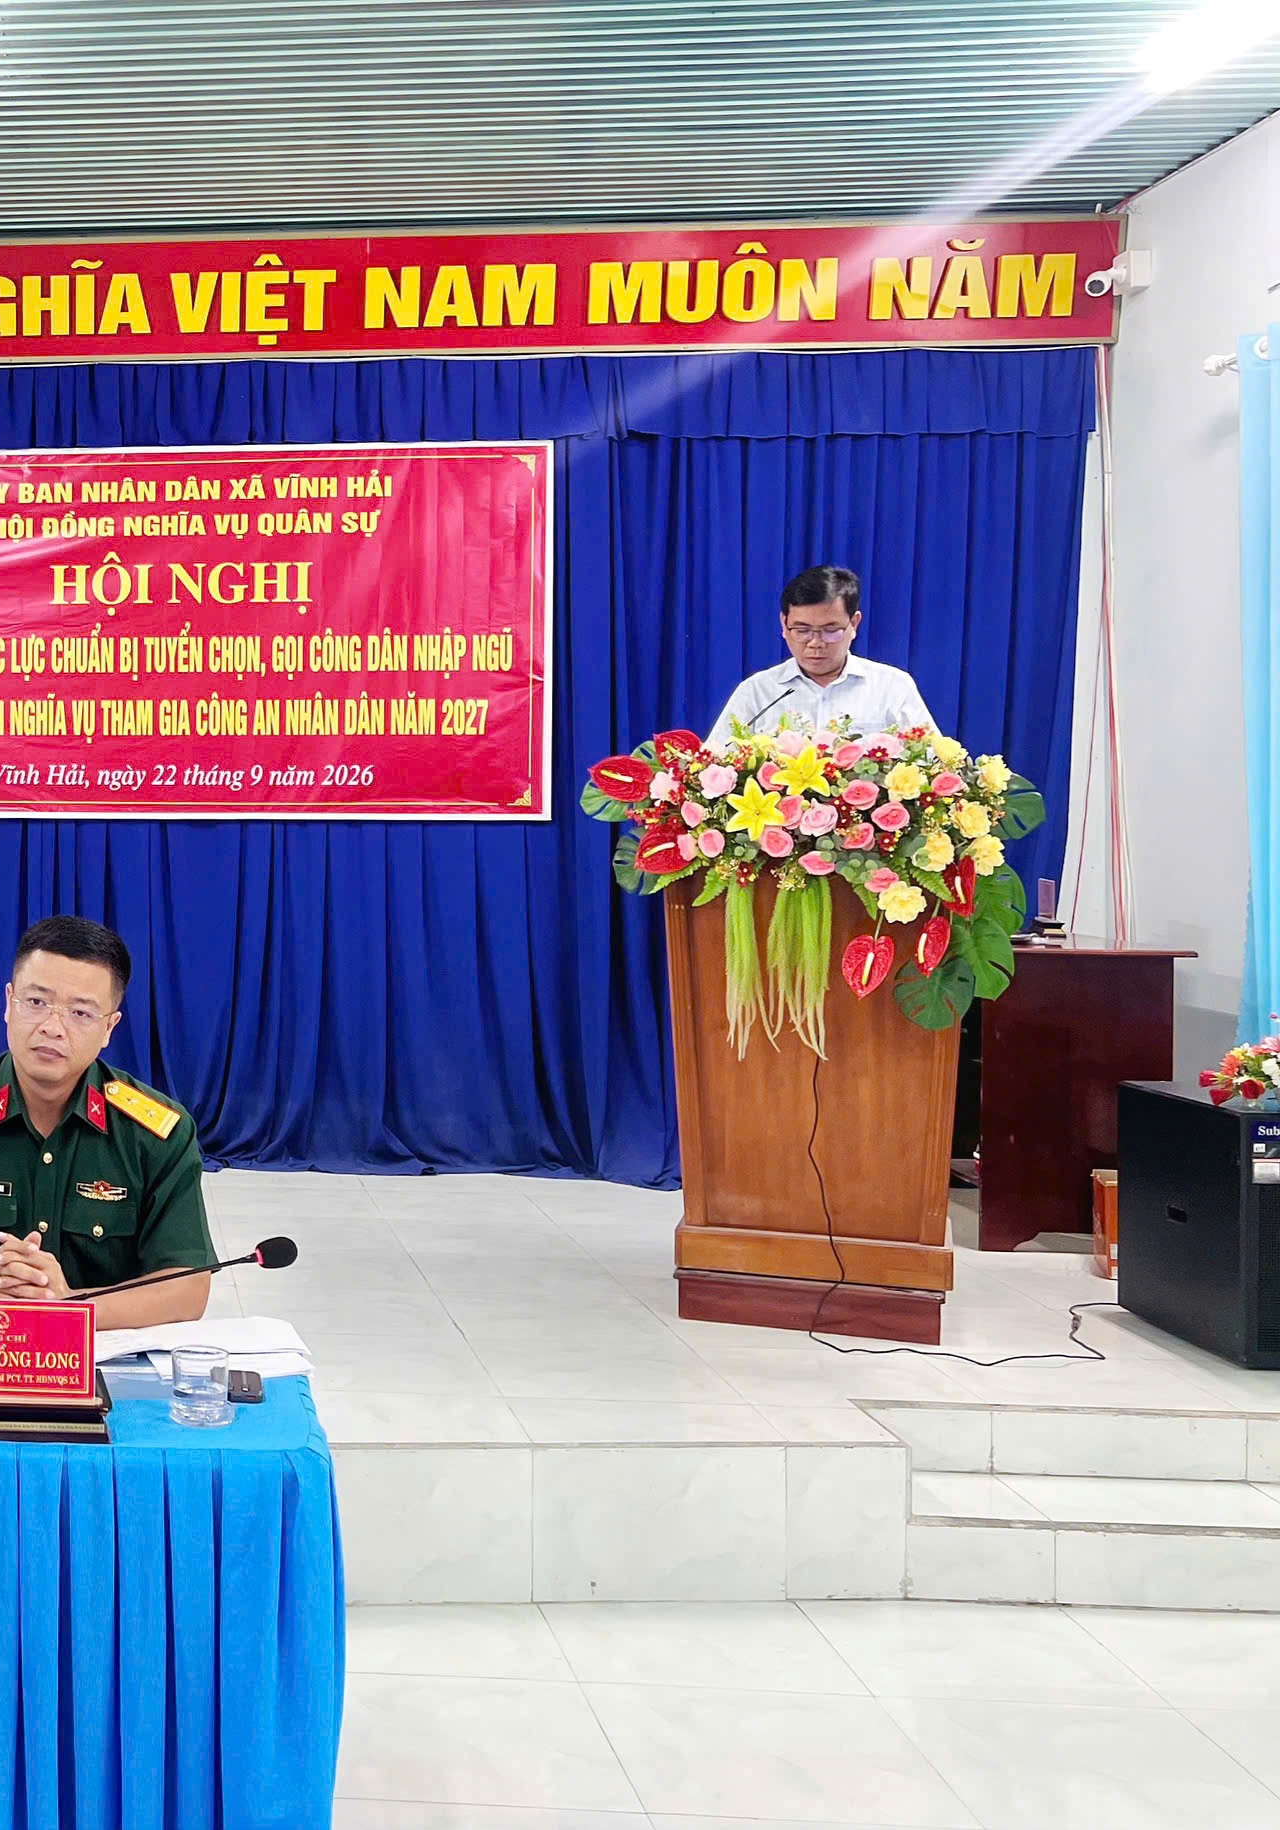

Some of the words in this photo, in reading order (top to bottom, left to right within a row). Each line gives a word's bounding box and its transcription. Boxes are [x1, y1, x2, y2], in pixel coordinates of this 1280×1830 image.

[170, 253, 337, 346] VIỆT
[365, 264, 557, 329] NAM
[587, 241, 841, 325] MUÔN
[869, 239, 1077, 321] NĂM
[17, 482, 73, 504] BAN
[81, 477, 157, 503] NHÂN
[165, 475, 221, 502] DÂN
[228, 474, 266, 500] XÃ
[273, 473, 338, 499] VĨNH
[346, 469, 393, 498] HẢI
[41, 511, 115, 538] ĐỒNG
[123, 511, 207, 537] NGHĨA
[214, 514, 249, 540] VỤ
[257, 508, 333, 537] QUÂN
[341, 509, 382, 538] SỰ
[49, 551, 154, 616] HỘI
[168, 561, 314, 615] NGHỊ
[11, 634, 46, 681] LỰC
[51, 622, 115, 674] CHUẨN
[119, 637, 139, 681] BỊ
[144, 621, 203, 673] TUYỂN
[208, 636, 266, 681] CHỌN,
[272, 636, 304, 681] GỌI
[309, 627, 362, 672] CÔNG
[367, 627, 408, 672] DÂN
[413, 627, 467, 679] NHẬP
[472, 627, 513, 672] NGŨ
[10, 693, 67, 737] NGHĨA
[71, 699, 96, 744] VỤ
[101, 699, 154, 736] THAM
[159, 699, 191, 737] GIA
[195, 692, 248, 736] CÔNG
[252, 699, 280, 736] AN
[285, 691, 339, 736] NHÂN
[344, 691, 385, 736] DÂN
[390, 691, 436, 736] NĂM
[441, 698, 489, 736] 2027
[45, 763, 90, 789] Hải,
[96, 765, 147, 791] ngày
[151, 765, 177, 786] 22
[183, 763, 245, 792] tháng
[250, 764, 264, 786] 9
[269, 766, 315, 786] năm
[321, 764, 374, 786] 2026
[6, 1333, 27, 1343] CHÍ
[35, 1351, 81, 1370] LONG
